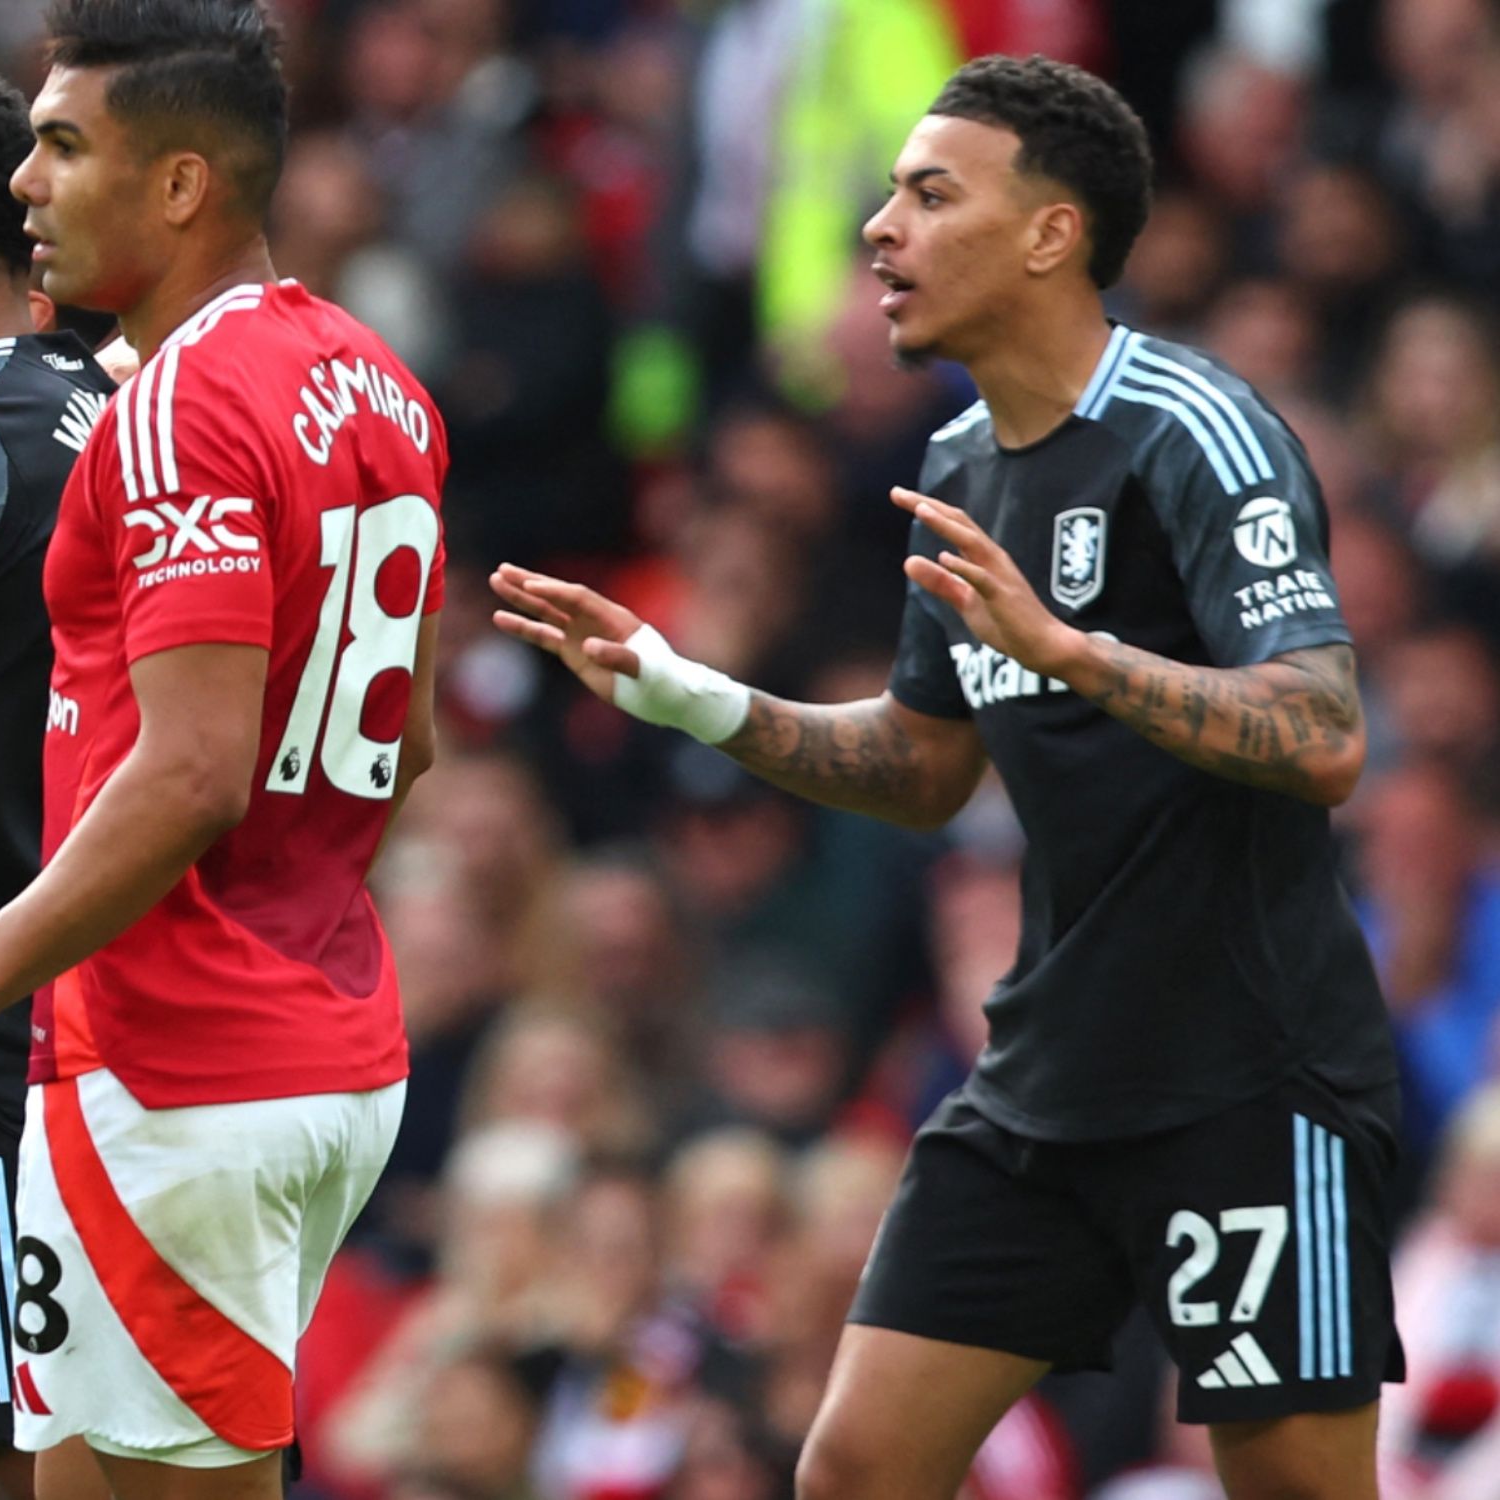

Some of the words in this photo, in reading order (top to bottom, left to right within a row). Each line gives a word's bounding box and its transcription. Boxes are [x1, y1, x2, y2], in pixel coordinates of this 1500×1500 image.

[291, 356, 431, 467] CASMIRO
[138, 555, 261, 590] TECHNOLOGY
[265, 494, 440, 800] 18
[1165, 1204, 1289, 1327] 27
